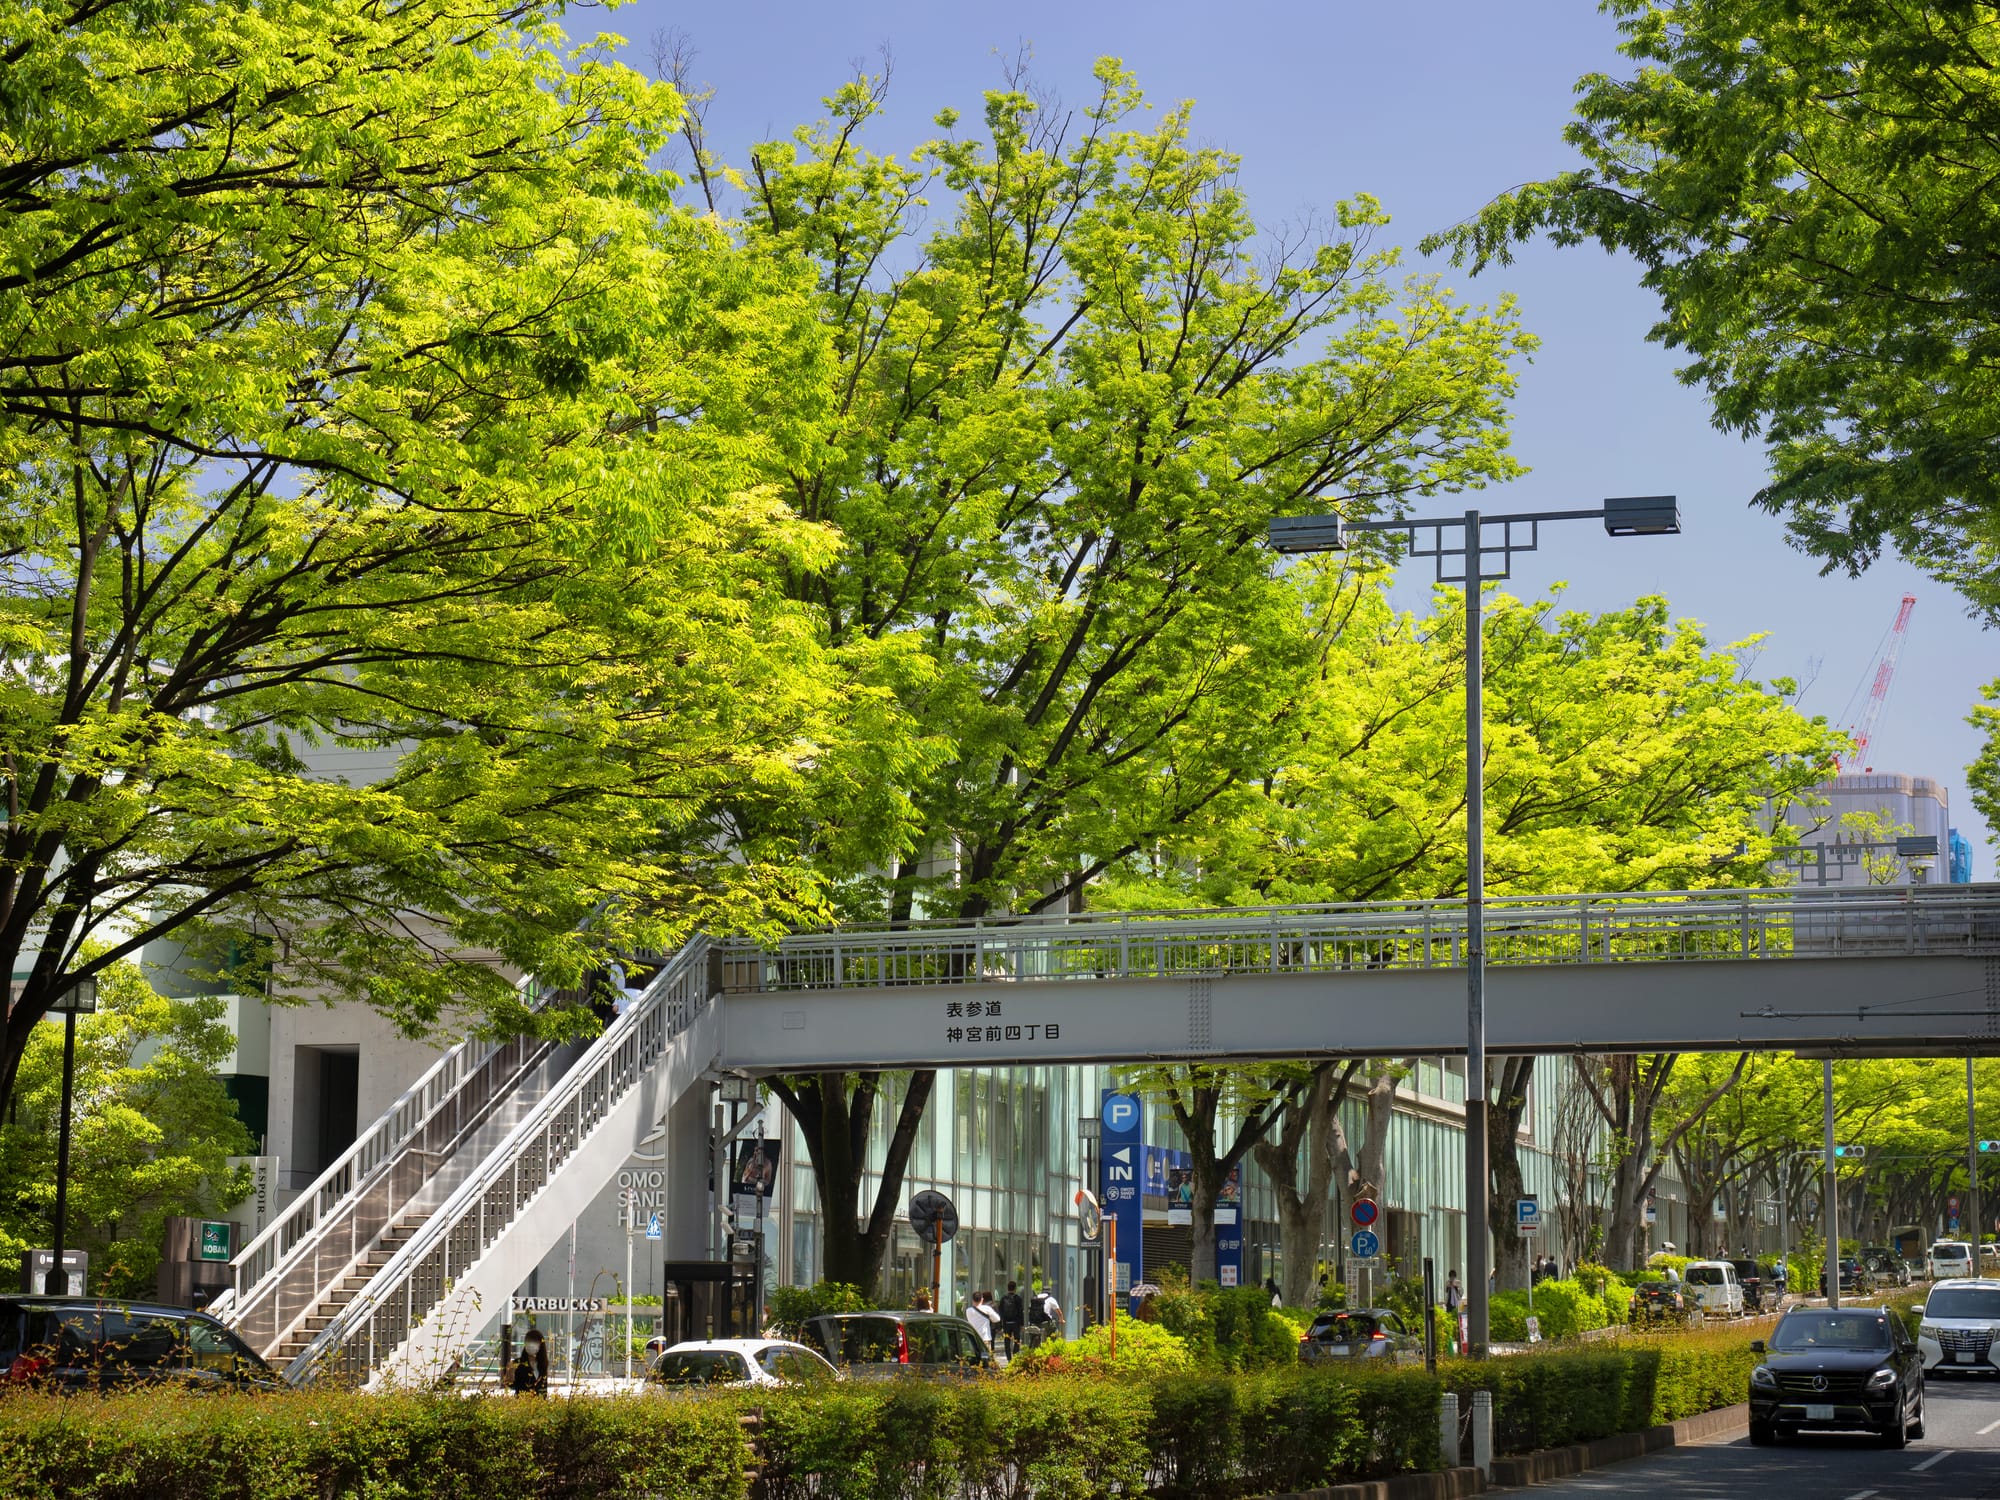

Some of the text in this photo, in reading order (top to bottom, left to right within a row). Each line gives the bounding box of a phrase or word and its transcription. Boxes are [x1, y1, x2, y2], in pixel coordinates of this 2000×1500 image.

[947, 1000, 1002, 1018] 表参道
[946, 1024, 1060, 1043] 神宮前四丁目
[1112, 1104, 1132, 1124] P
[617, 1171, 665, 1188] OMO
[1109, 1166, 1133, 1181] IN
[257, 1167, 267, 1213] ESPOIR
[1519, 1202, 1537, 1221] P
[203, 1244, 227, 1254] KOBAN
[1357, 1237, 1369, 1255] P
